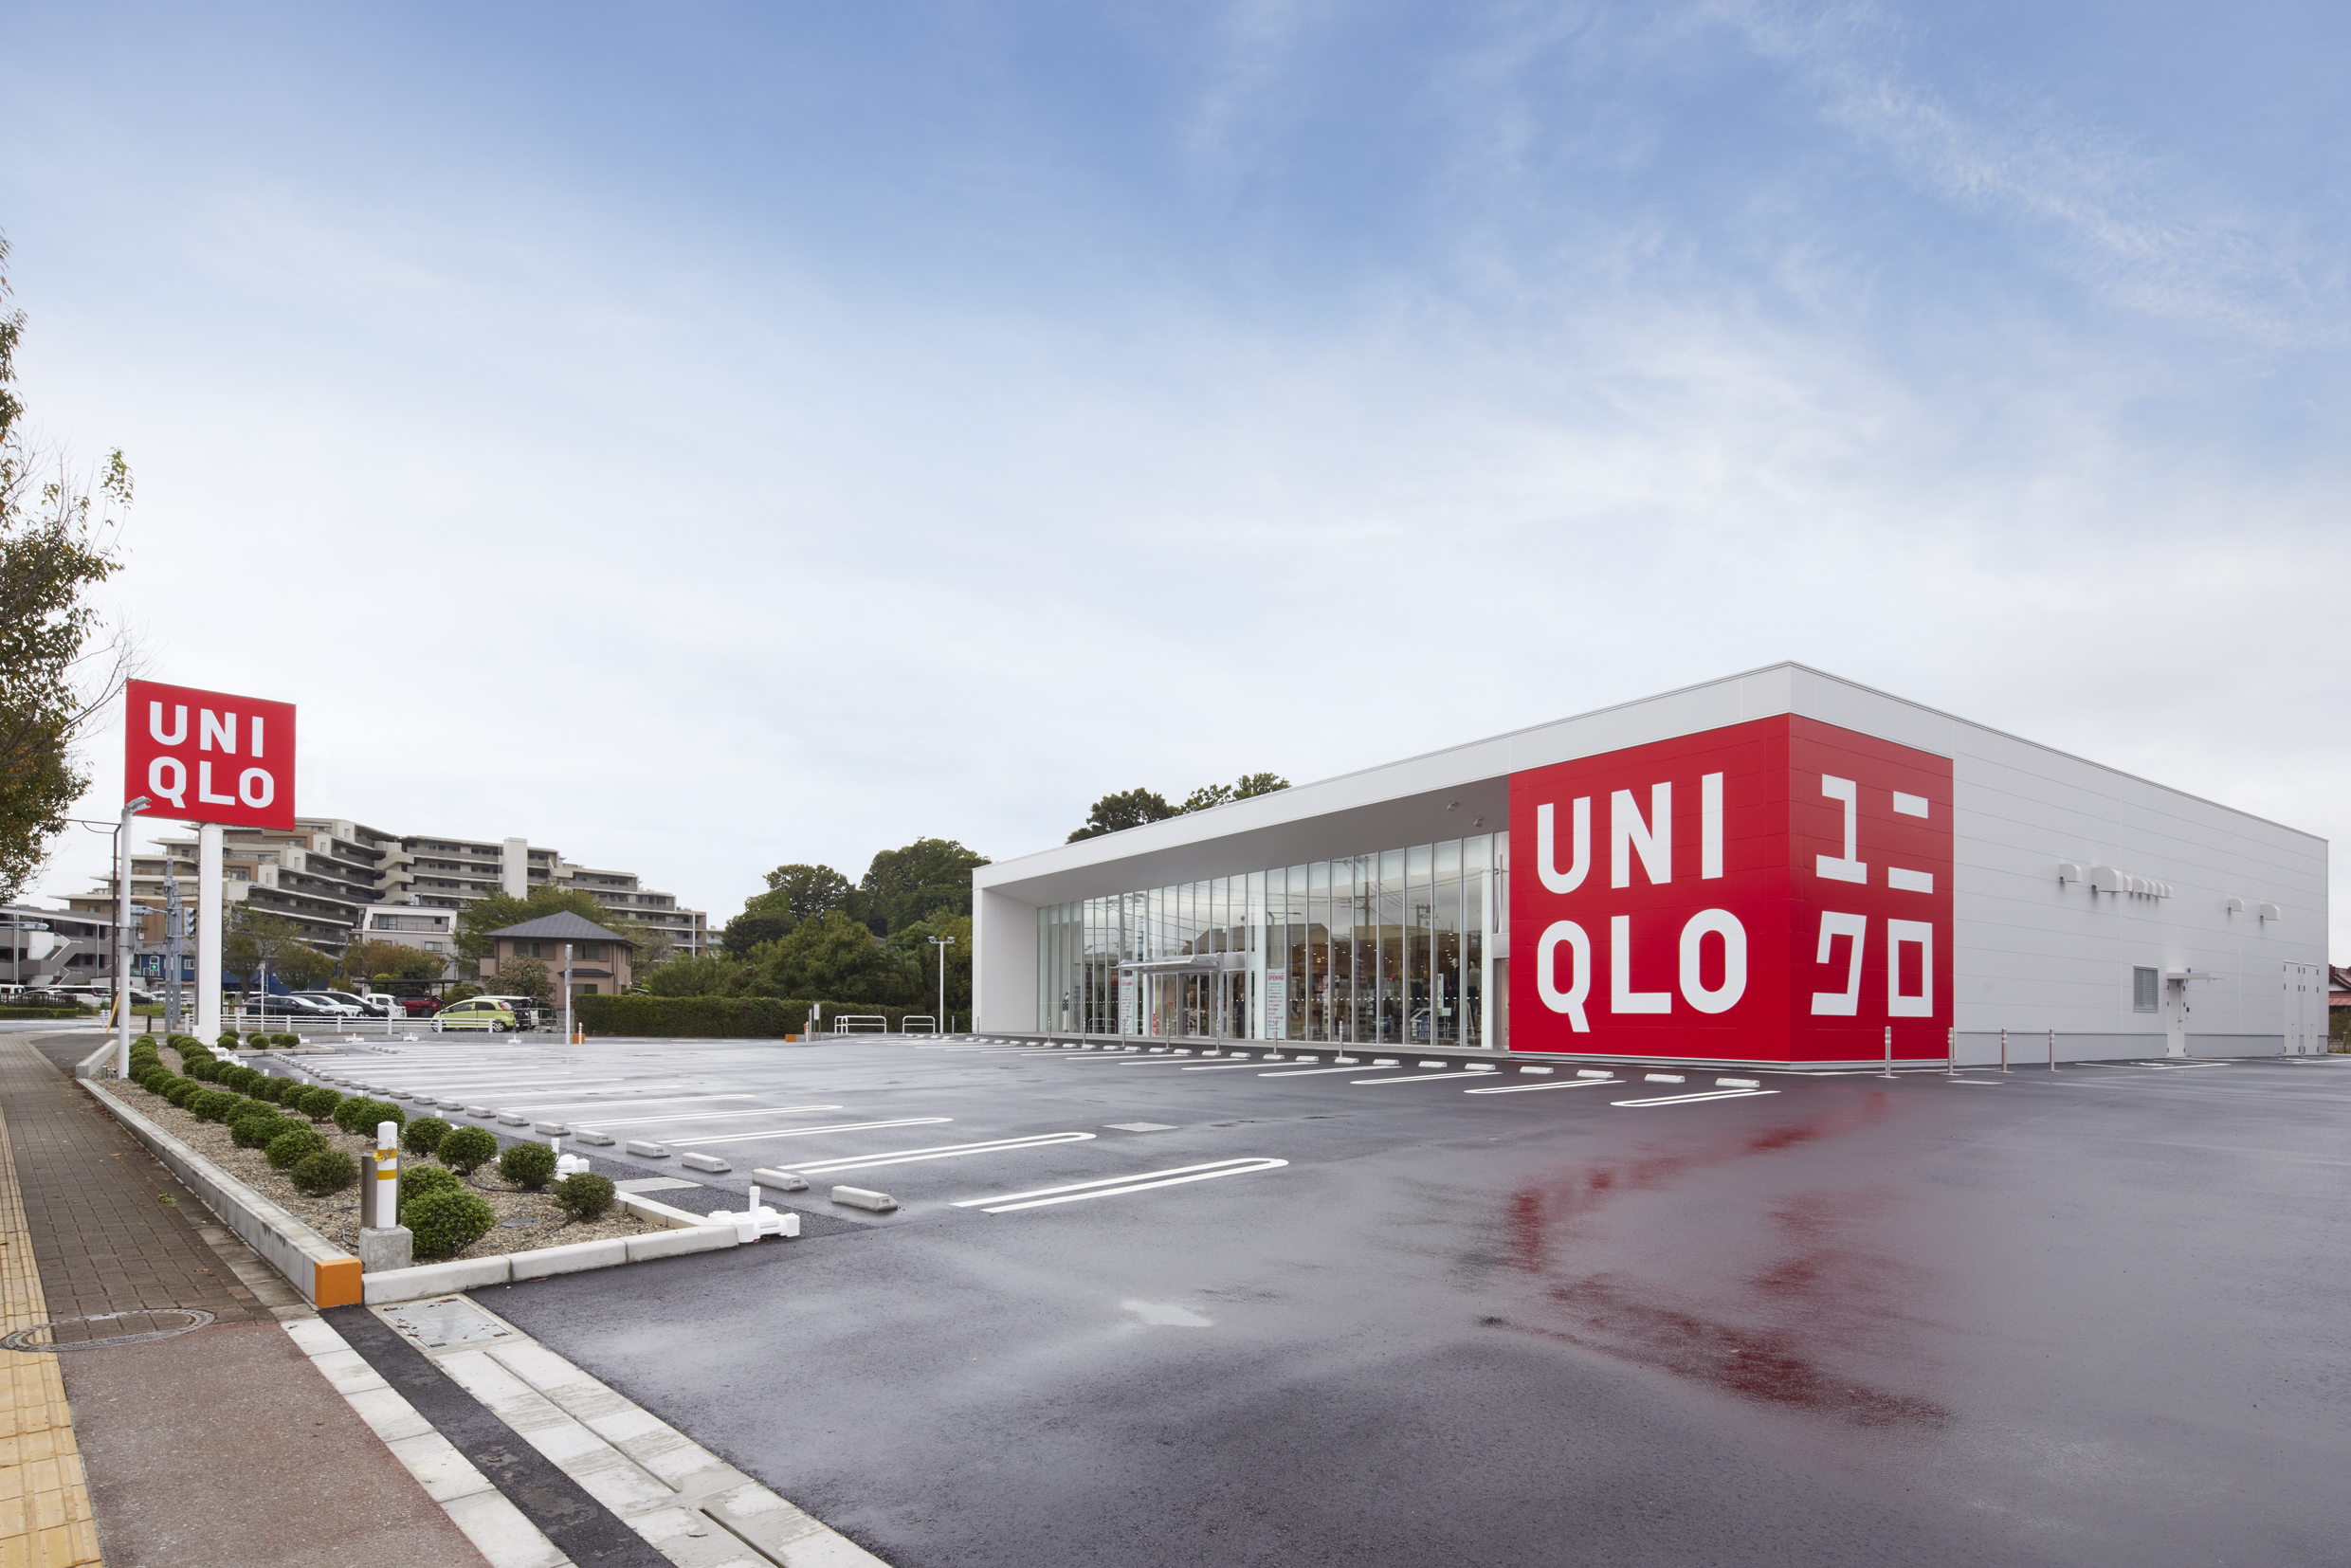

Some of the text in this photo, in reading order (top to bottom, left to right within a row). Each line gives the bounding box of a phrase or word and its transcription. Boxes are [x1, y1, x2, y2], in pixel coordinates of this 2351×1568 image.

[149, 757, 274, 808] QLO
[150, 702, 264, 757] UNI
[1538, 772, 1722, 894] UNI
[1816, 774, 1933, 893] ユニ
[1538, 909, 1746, 1032] QLO
[1812, 911, 1933, 1017] クロ
